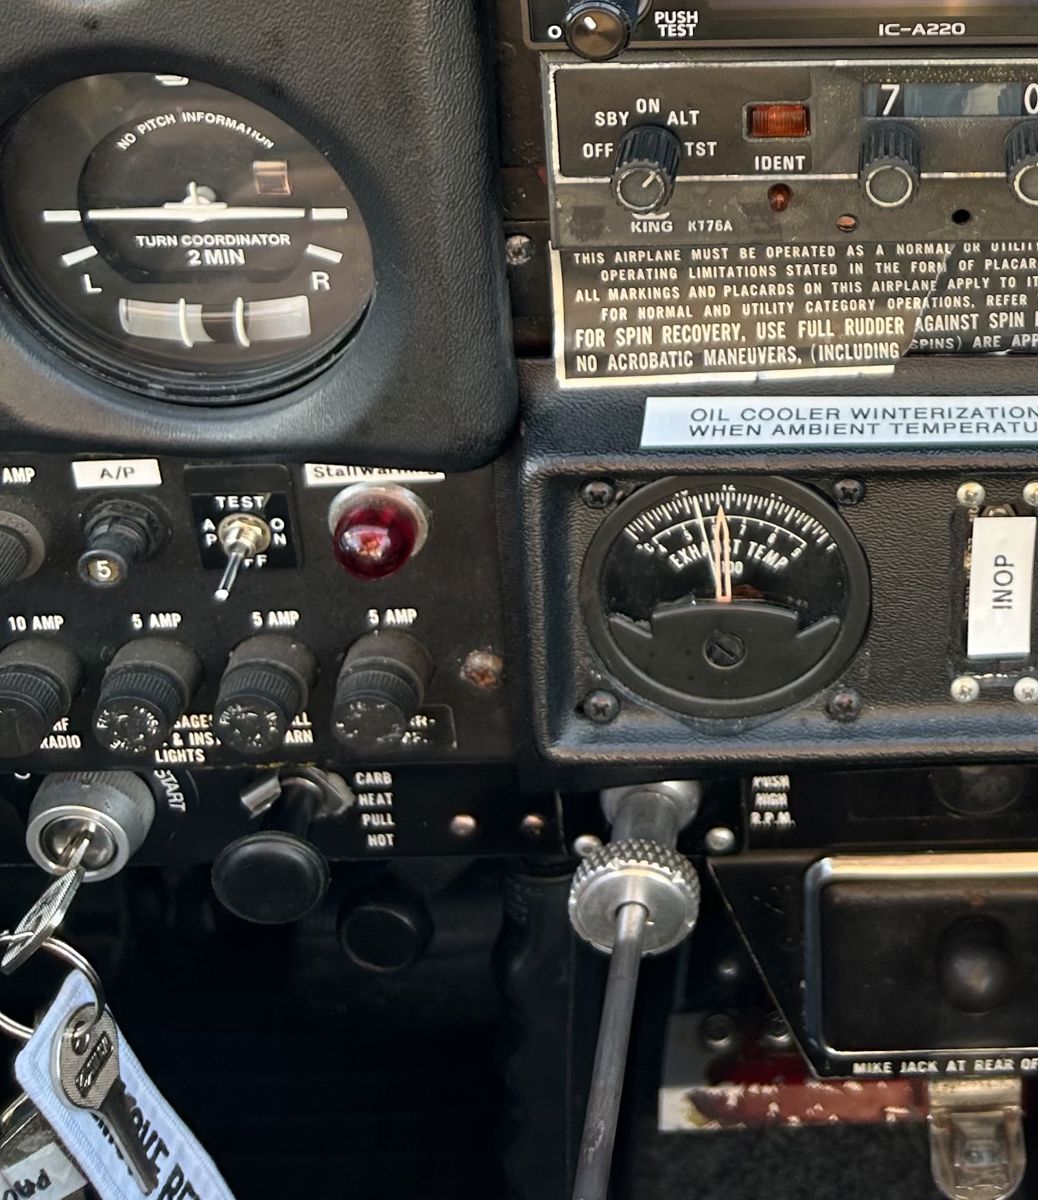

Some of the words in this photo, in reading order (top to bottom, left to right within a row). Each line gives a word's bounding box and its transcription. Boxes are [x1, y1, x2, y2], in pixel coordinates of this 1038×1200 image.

[654, 10, 699, 24] PUSH
[657, 24, 697, 38] TEST
[878, 22, 966, 36] IC-A220
[635, 98, 661, 114] ON
[594, 110, 630, 127] SBY
[666, 109, 700, 126] ALT
[116, 132, 137, 151] NO
[137, 113, 177, 136] PITCH
[582, 142, 614, 159] OFF
[684, 140, 718, 157] TST
[754, 155, 806, 171] IDENT
[630, 219, 673, 234] KING
[688, 219, 733, 233] KT76A
[135, 234, 179, 248] TURN
[181, 233, 292, 248] COORDINATOR
[187, 249, 202, 265] 2
[204, 249, 246, 266] MIN
[601, 307, 627, 322] FOR
[638, 305, 693, 321] NORMAL
[704, 304, 731, 318] AND
[742, 301, 795, 316] UTILITY
[805, 298, 876, 314] CATEGORY
[986, 294, 1028, 307] REFER
[575, 329, 606, 349] FOR
[615, 326, 653, 347] SPIN
[662, 322, 746, 345] RECOVERY,
[756, 321, 786, 340] USE
[798, 319, 835, 338] FULL
[845, 316, 905, 336] RUDDER
[915, 313, 979, 332] AGAINST
[989, 311, 1025, 329] SPIN
[576, 355, 598, 373] NO
[607, 351, 694, 372] ACROBATIC
[810, 342, 900, 365] (INCLUDING
[910, 335, 963, 352] SPINS)
[972, 334, 1001, 349] ARE
[690, 408, 730, 422] OIL
[741, 407, 841, 422] COOLER
[689, 424, 762, 437] WHEN
[771, 422, 881, 436] AMBIENT
[2, 467, 36, 483] AMP
[100, 466, 135, 480] A/P
[215, 495, 265, 509] TEST
[747, 541, 789, 570] TEMP
[991, 554, 1015, 610] INOP
[8, 615, 27, 631] 10
[32, 614, 65, 631] AMP
[131, 613, 143, 629] 5
[150, 612, 182, 628] AMP
[251, 611, 263, 627] 5
[266, 610, 299, 627] AMP
[367, 609, 379, 625] 5
[383, 608, 418, 624] AMP
[154, 748, 206, 763] LIGHTS
[355, 771, 392, 786] CARB
[358, 792, 393, 807] HEAT
[362, 813, 395, 827] PULL
[367, 832, 394, 847] HOT
[852, 1061, 894, 1074] MIKE
[900, 1060, 939, 1073] JACK
[946, 1059, 967, 1072] AT
[974, 1058, 1015, 1072] REAR
